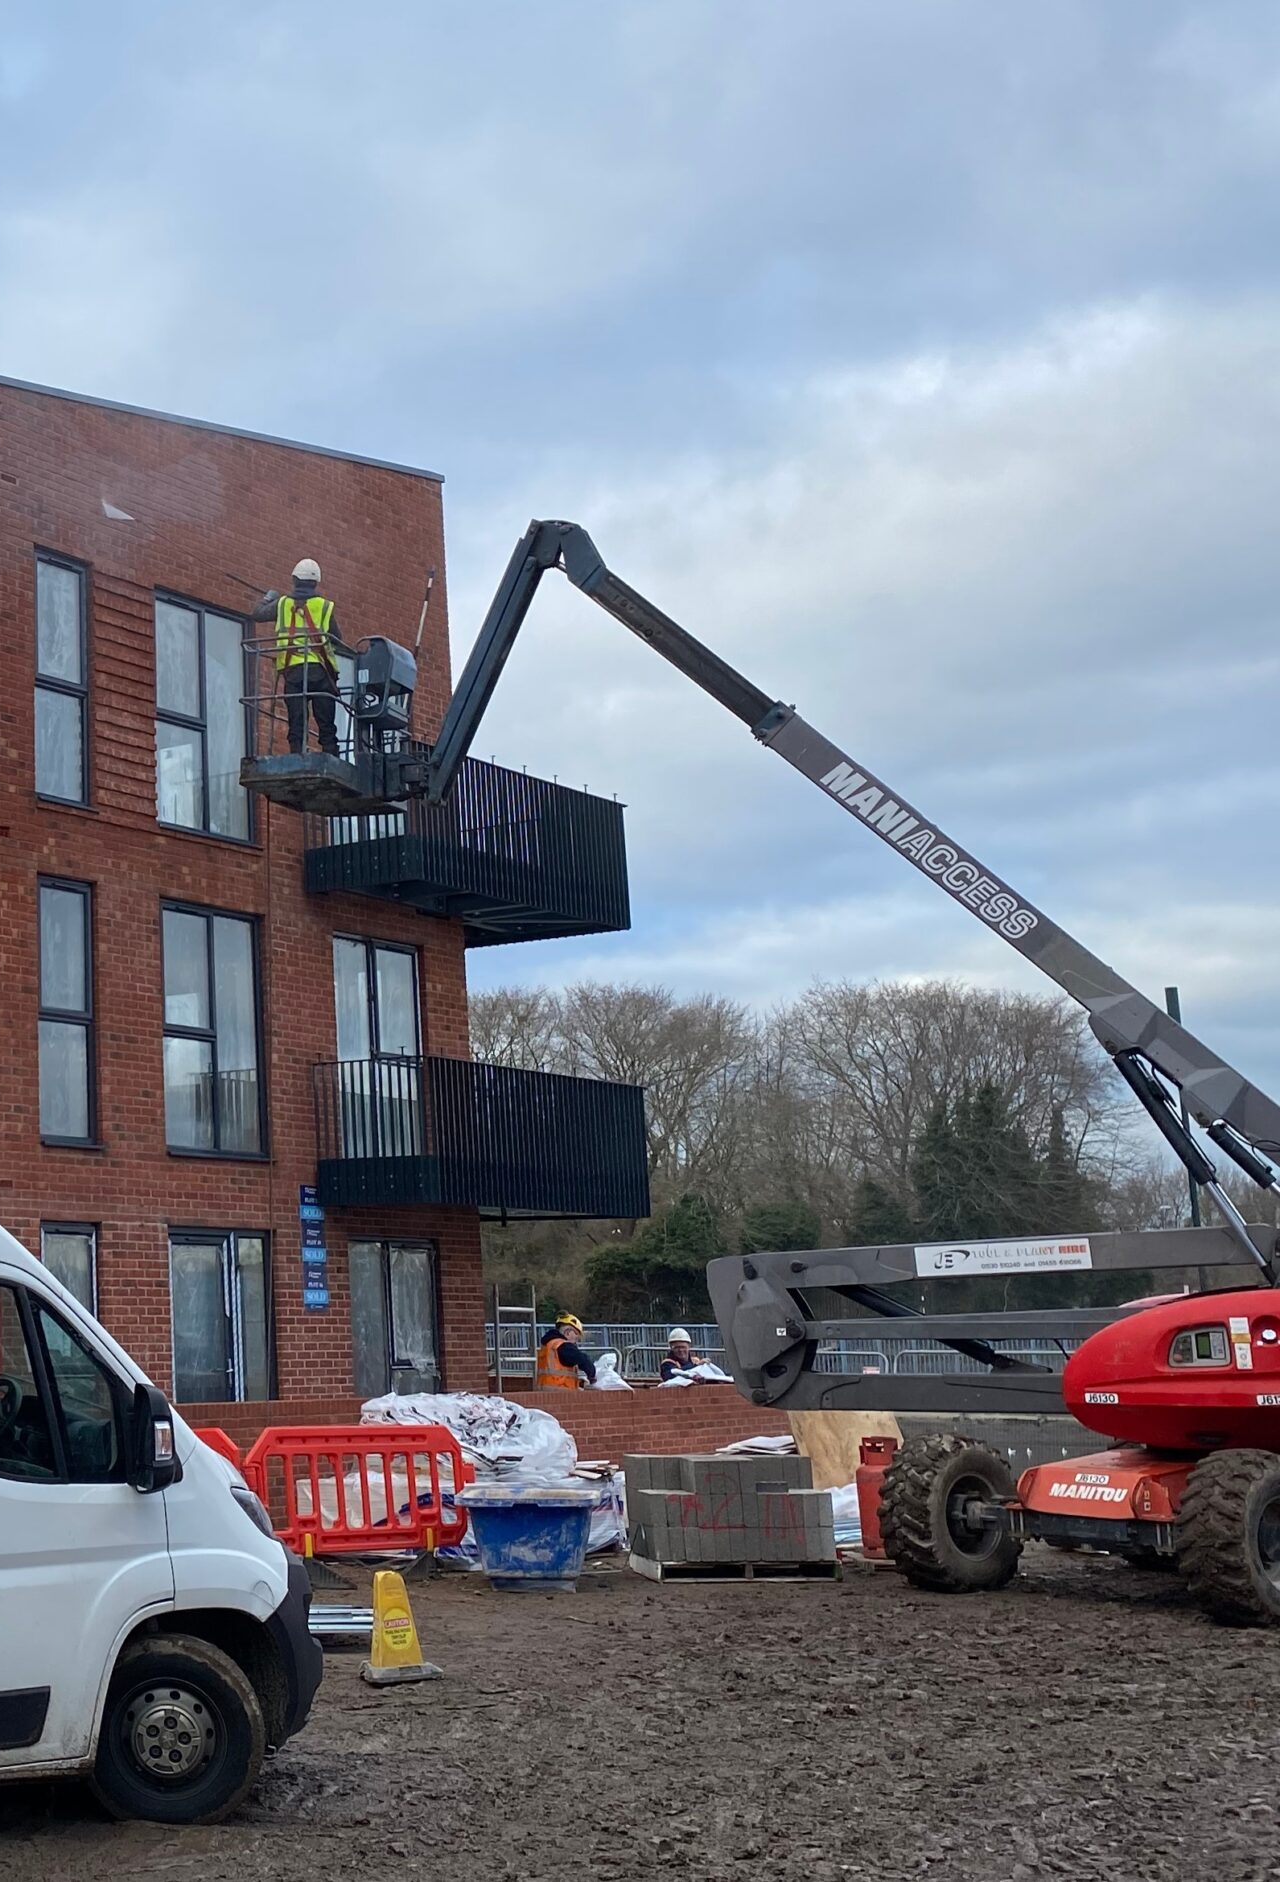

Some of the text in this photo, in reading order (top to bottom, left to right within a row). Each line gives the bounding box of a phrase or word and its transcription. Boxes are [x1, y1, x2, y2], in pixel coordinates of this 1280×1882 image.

[820, 761, 1039, 939] MANIACCESS
[303, 1207, 322, 1218] SOLD
[304, 1250, 324, 1260] SOLD
[1058, 1244, 1087, 1255] HIRE
[306, 1291, 326, 1302] SOLD
[1088, 1393, 1116, 1403] J6130
[1261, 1395, 1280, 1405] J61
[1049, 1483, 1128, 1502] MANITOU
